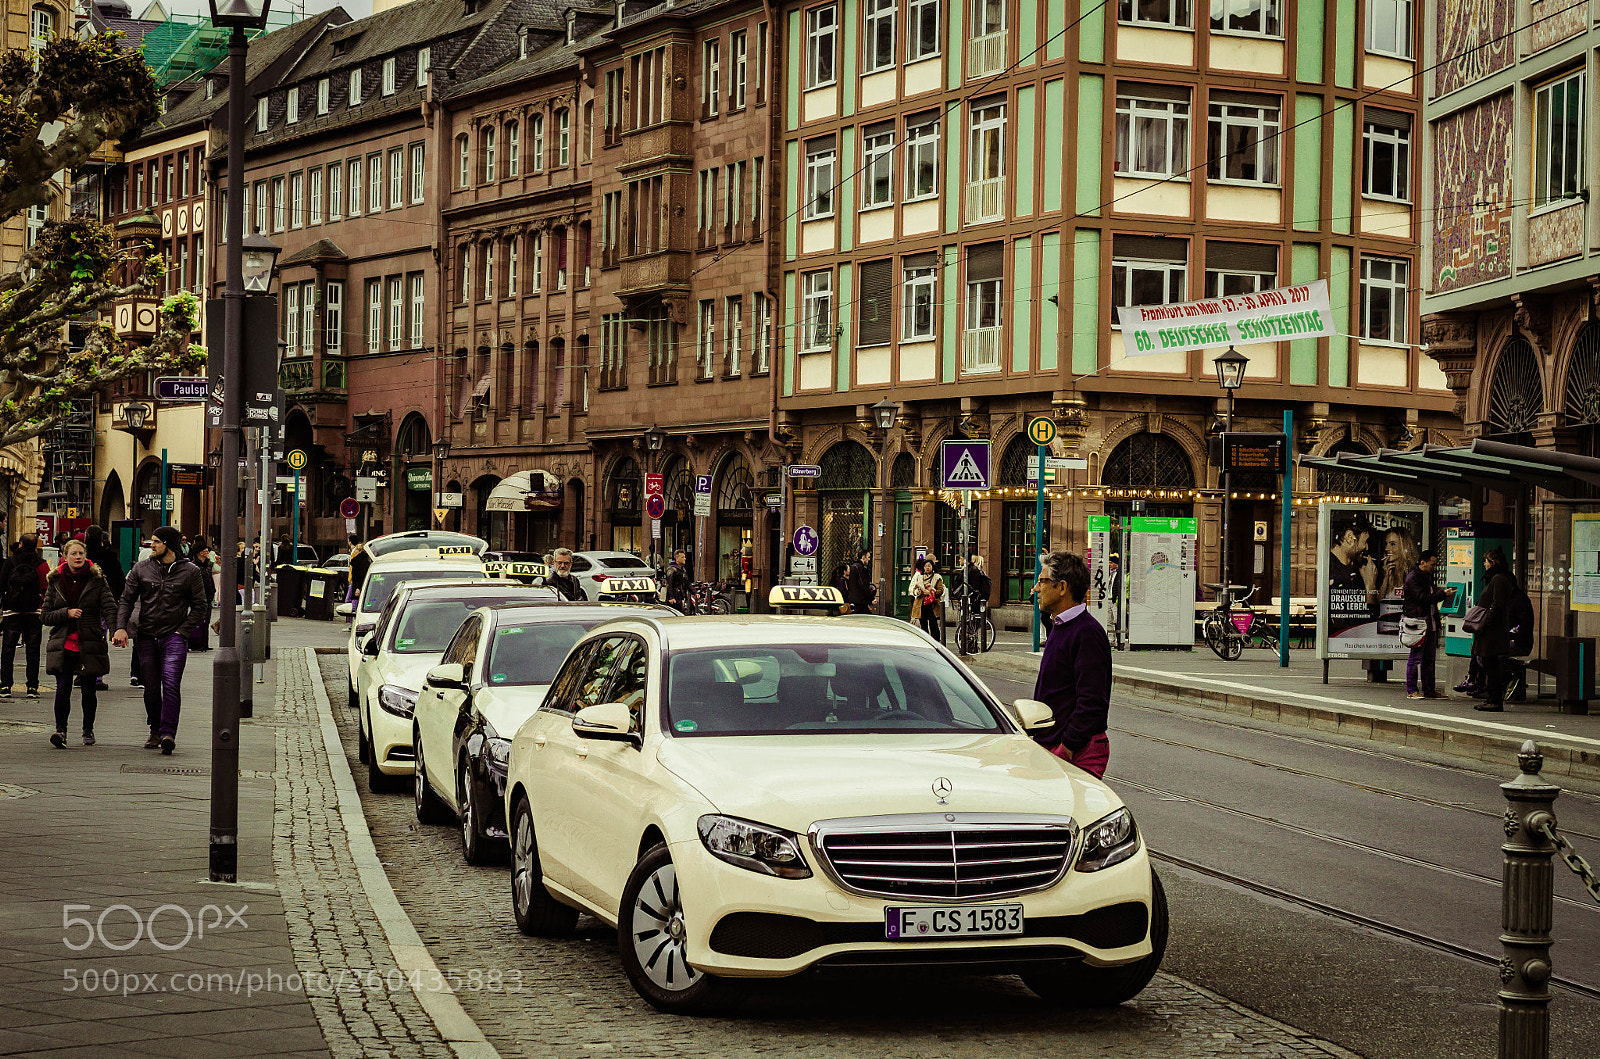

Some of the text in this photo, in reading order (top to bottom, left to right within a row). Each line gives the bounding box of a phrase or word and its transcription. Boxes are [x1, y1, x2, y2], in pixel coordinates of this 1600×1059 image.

[1140, 305, 1184, 321] Frankfurt
[1183, 304, 1200, 317] am
[1196, 301, 1222, 315] Main
[1288, 286, 1310, 303] 2017
[1134, 308, 1324, 352] 60. DEUTSCHER SCHÜTZENTAG
[173, 383, 209, 398] Paulspl
[1037, 423, 1049, 439] H
[294, 454, 302, 465] H
[698, 477, 708, 491] P
[69, 509, 75, 517] 2
[1389, 518, 1412, 532] CLUB
[442, 546, 469, 554] TAXI
[487, 563, 507, 571] TAX
[516, 564, 543, 574] TAXI
[611, 579, 647, 591] TAXI
[783, 587, 834, 600] TAXI
[1331, 594, 1366, 602] DRAUSSEN
[1331, 602, 1370, 611] DAS LEBEN.
[902, 908, 1020, 934] F CS 1583
